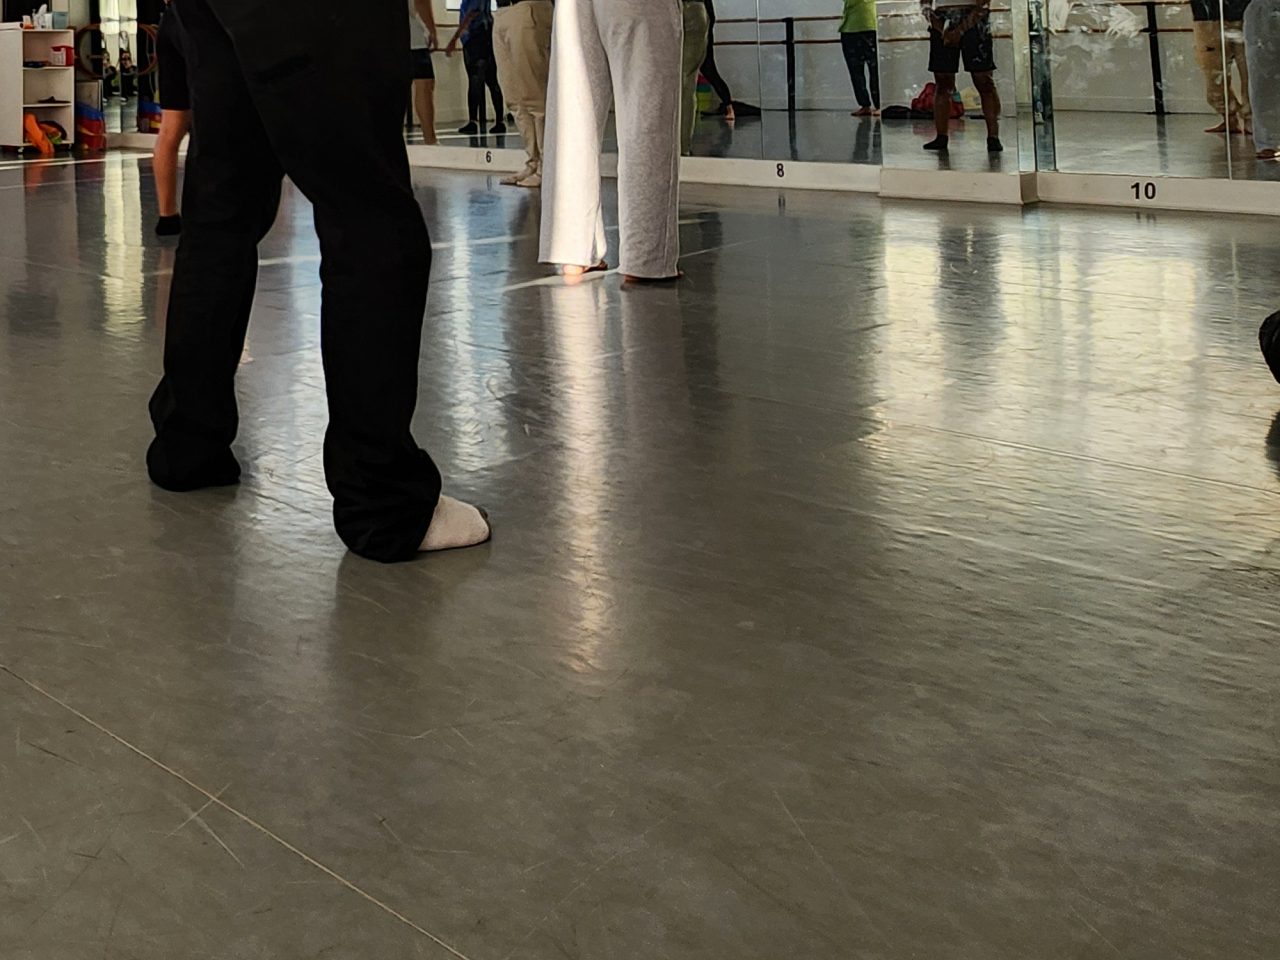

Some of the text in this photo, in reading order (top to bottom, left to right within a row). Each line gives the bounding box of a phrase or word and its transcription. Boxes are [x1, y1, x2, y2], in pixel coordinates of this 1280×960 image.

[485, 150, 492, 163] 6
[776, 162, 785, 178] 8
[1130, 182, 1157, 200] 10
